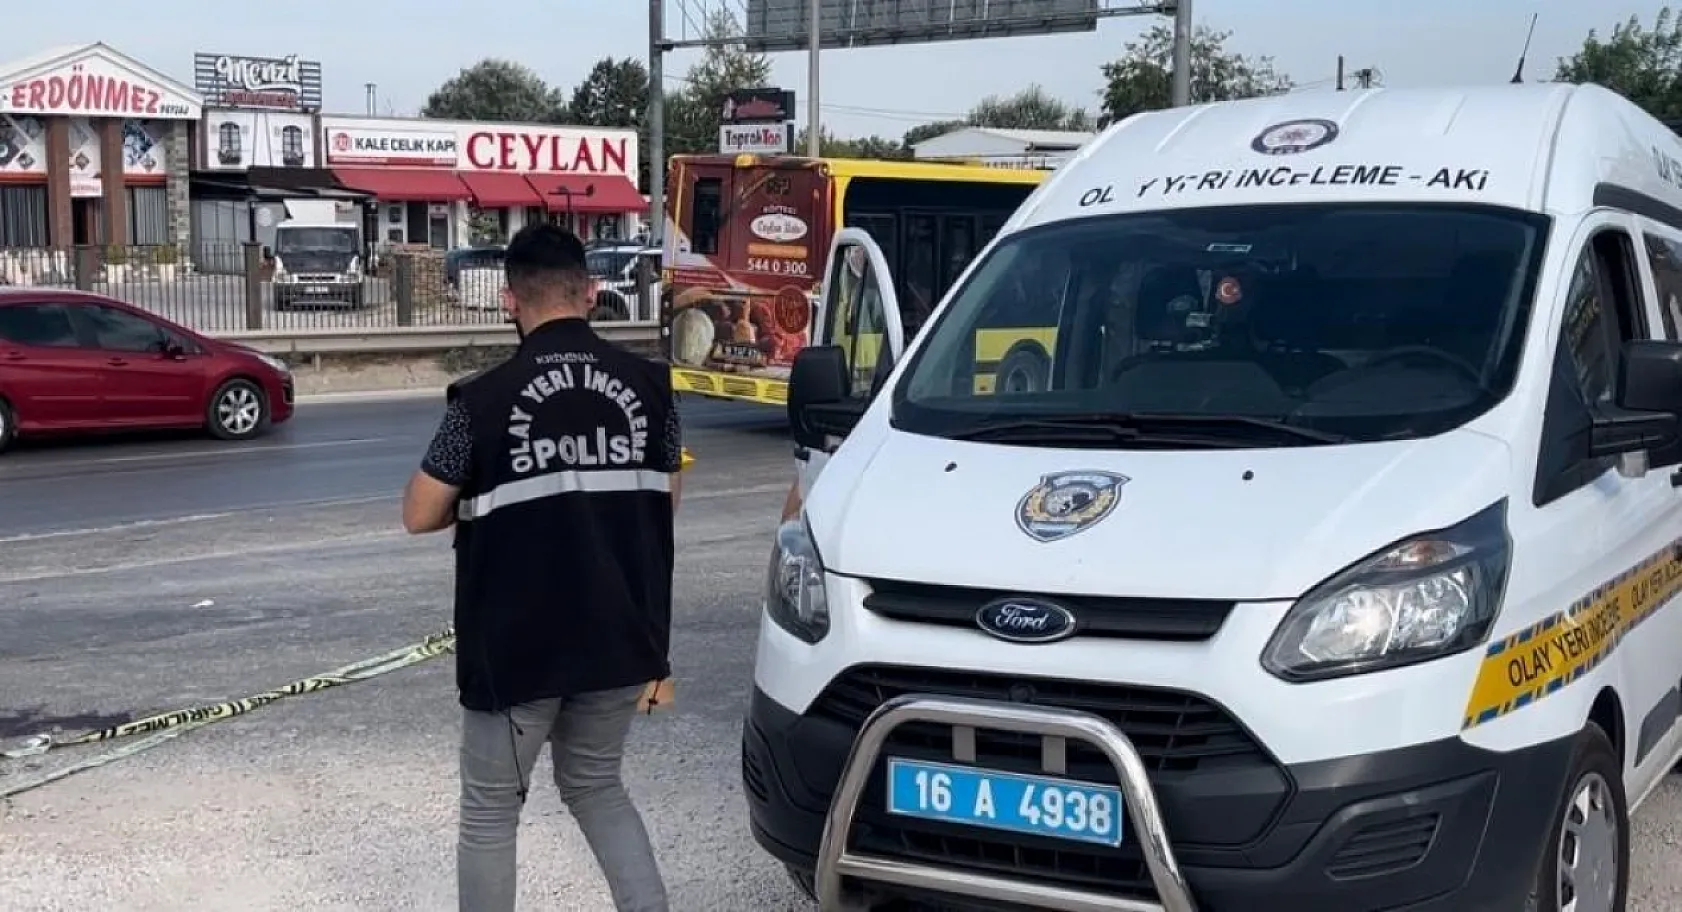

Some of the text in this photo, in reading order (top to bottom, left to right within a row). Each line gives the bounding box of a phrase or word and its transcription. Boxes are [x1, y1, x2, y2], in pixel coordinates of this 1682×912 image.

[12, 65, 161, 113] ERDÖNMEZ
[355, 138, 388, 150] KALE
[466, 132, 628, 172] CEYLAN
[748, 258, 769, 271] 544
[784, 260, 807, 274] 300
[508, 405, 533, 473] OLAY
[532, 426, 630, 469] POLİS
[996, 603, 1050, 631] Ford
[1508, 641, 1553, 686] OLAY
[915, 770, 1112, 834] 16 A 4938
